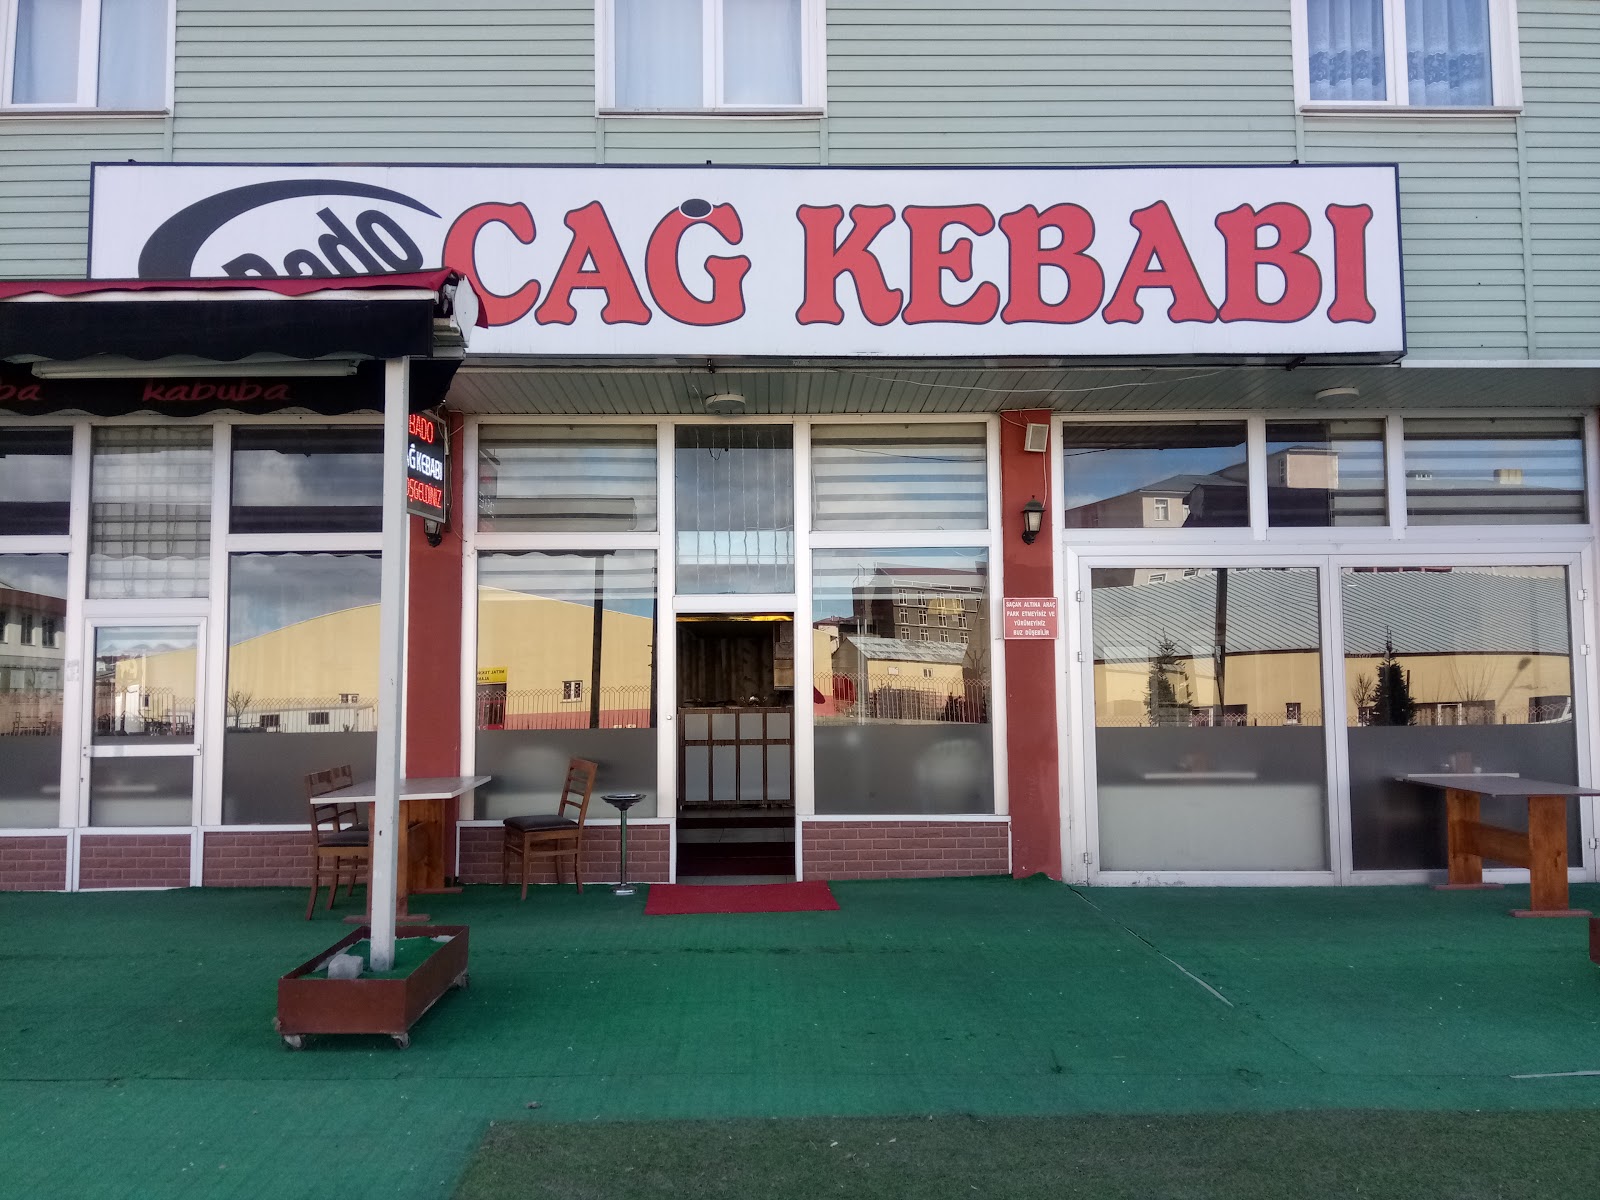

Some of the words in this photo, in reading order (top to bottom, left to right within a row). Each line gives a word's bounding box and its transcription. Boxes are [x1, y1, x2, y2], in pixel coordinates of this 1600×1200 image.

[796, 200, 1377, 326] KEBABI
[408, 414, 434, 443] BADO
[416, 451, 443, 481] KEBABI
